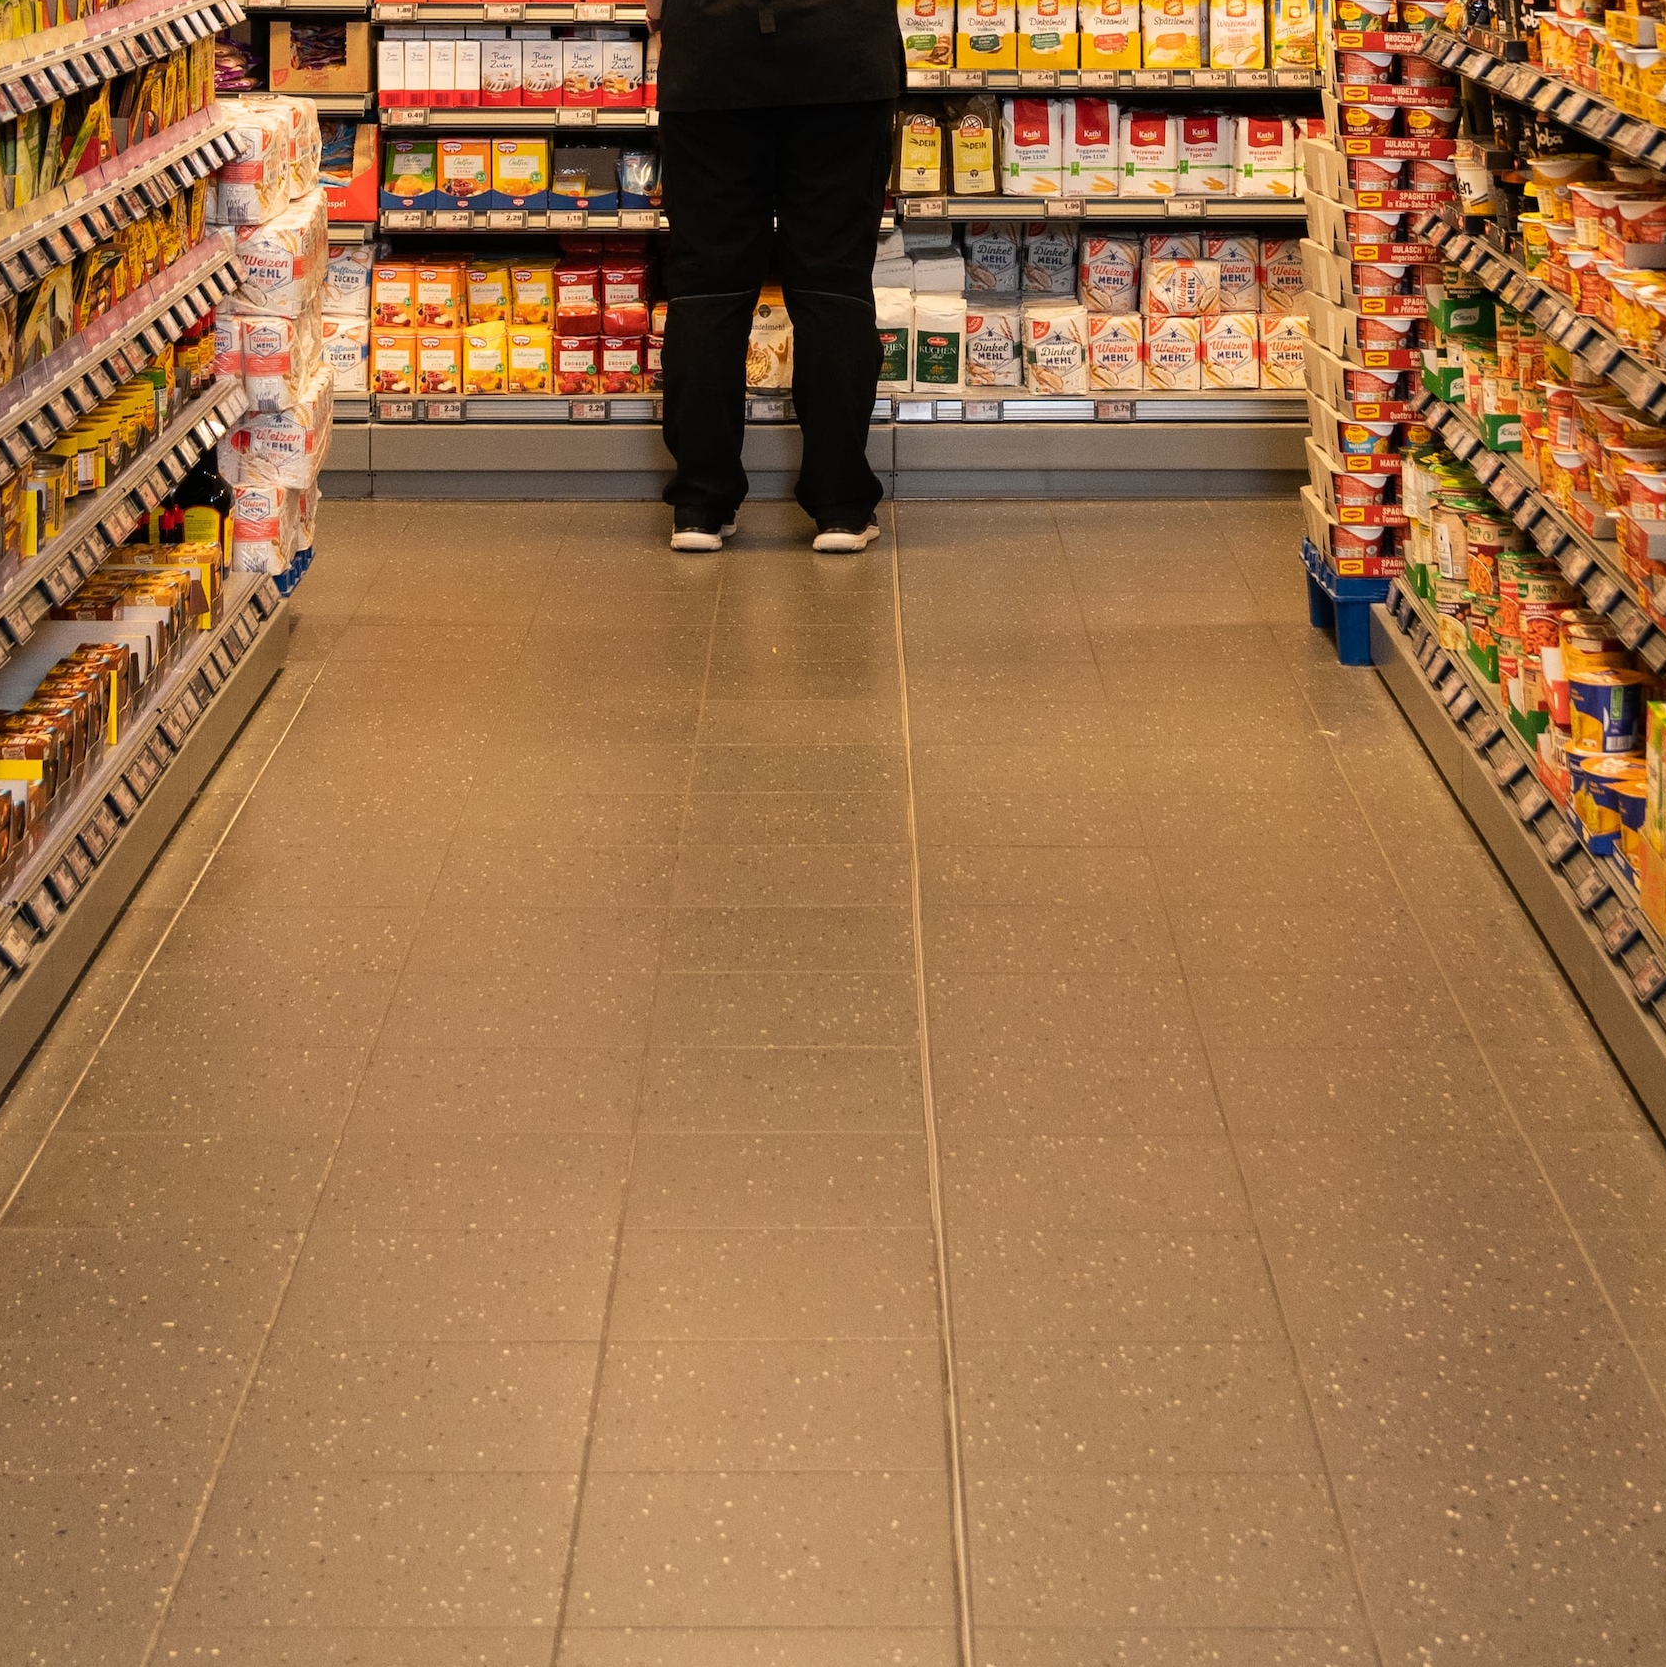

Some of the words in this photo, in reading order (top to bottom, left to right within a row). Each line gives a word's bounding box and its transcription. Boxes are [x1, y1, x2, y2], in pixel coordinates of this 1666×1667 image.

[906, 17, 944, 27] Dinkelmehl
[968, 17, 1005, 27] Dinkelmehl
[1029, 17, 1067, 27] Dinkelmehl
[1093, 17, 1129, 26] Pizzamehl
[1154, 16, 1194, 26] Spätzlemehl
[1217, 19, 1257, 27] Weizenmehl
[1384, 34, 1416, 43] BROCCOLI
[573, 53, 591, 62] Hagel
[1392, 87, 1418, 95] NUDELN
[1370, 95, 1448, 105] Tomaten-Mozzarella-Sauce
[1192, 128, 1209, 136] Kathi
[918, 139, 936, 147] DEIN
[1385, 140, 1415, 149] GULASCH
[1418, 141, 1430, 150] Topf
[1384, 149, 1419, 157] ungarischer
[1400, 192, 1436, 200] SPAGHETTI
[977, 245, 1012, 254] Dinkel
[1034, 246, 1068, 255] Dinkel
[1392, 246, 1422, 254] GULASCH
[1038, 256, 1063, 264] MEHL
[331, 265, 365, 274] Raffinade
[1093, 266, 1130, 277] Weizen
[1099, 276, 1124, 284] MEHL
[1178, 271, 1187, 309] Weizen
[1187, 277, 1195, 303] MEHL
[1452, 313, 1476, 321] Knorr
[325, 344, 359, 353] Raffinade
[1096, 344, 1133, 353] Weizen
[1154, 344, 1191, 353] Weizen
[1210, 341, 1247, 350] Weizen
[919, 347, 956, 355] KUCHEN
[1040, 348, 1077, 356] Dinkel
[330, 352, 355, 360] ZUCKER
